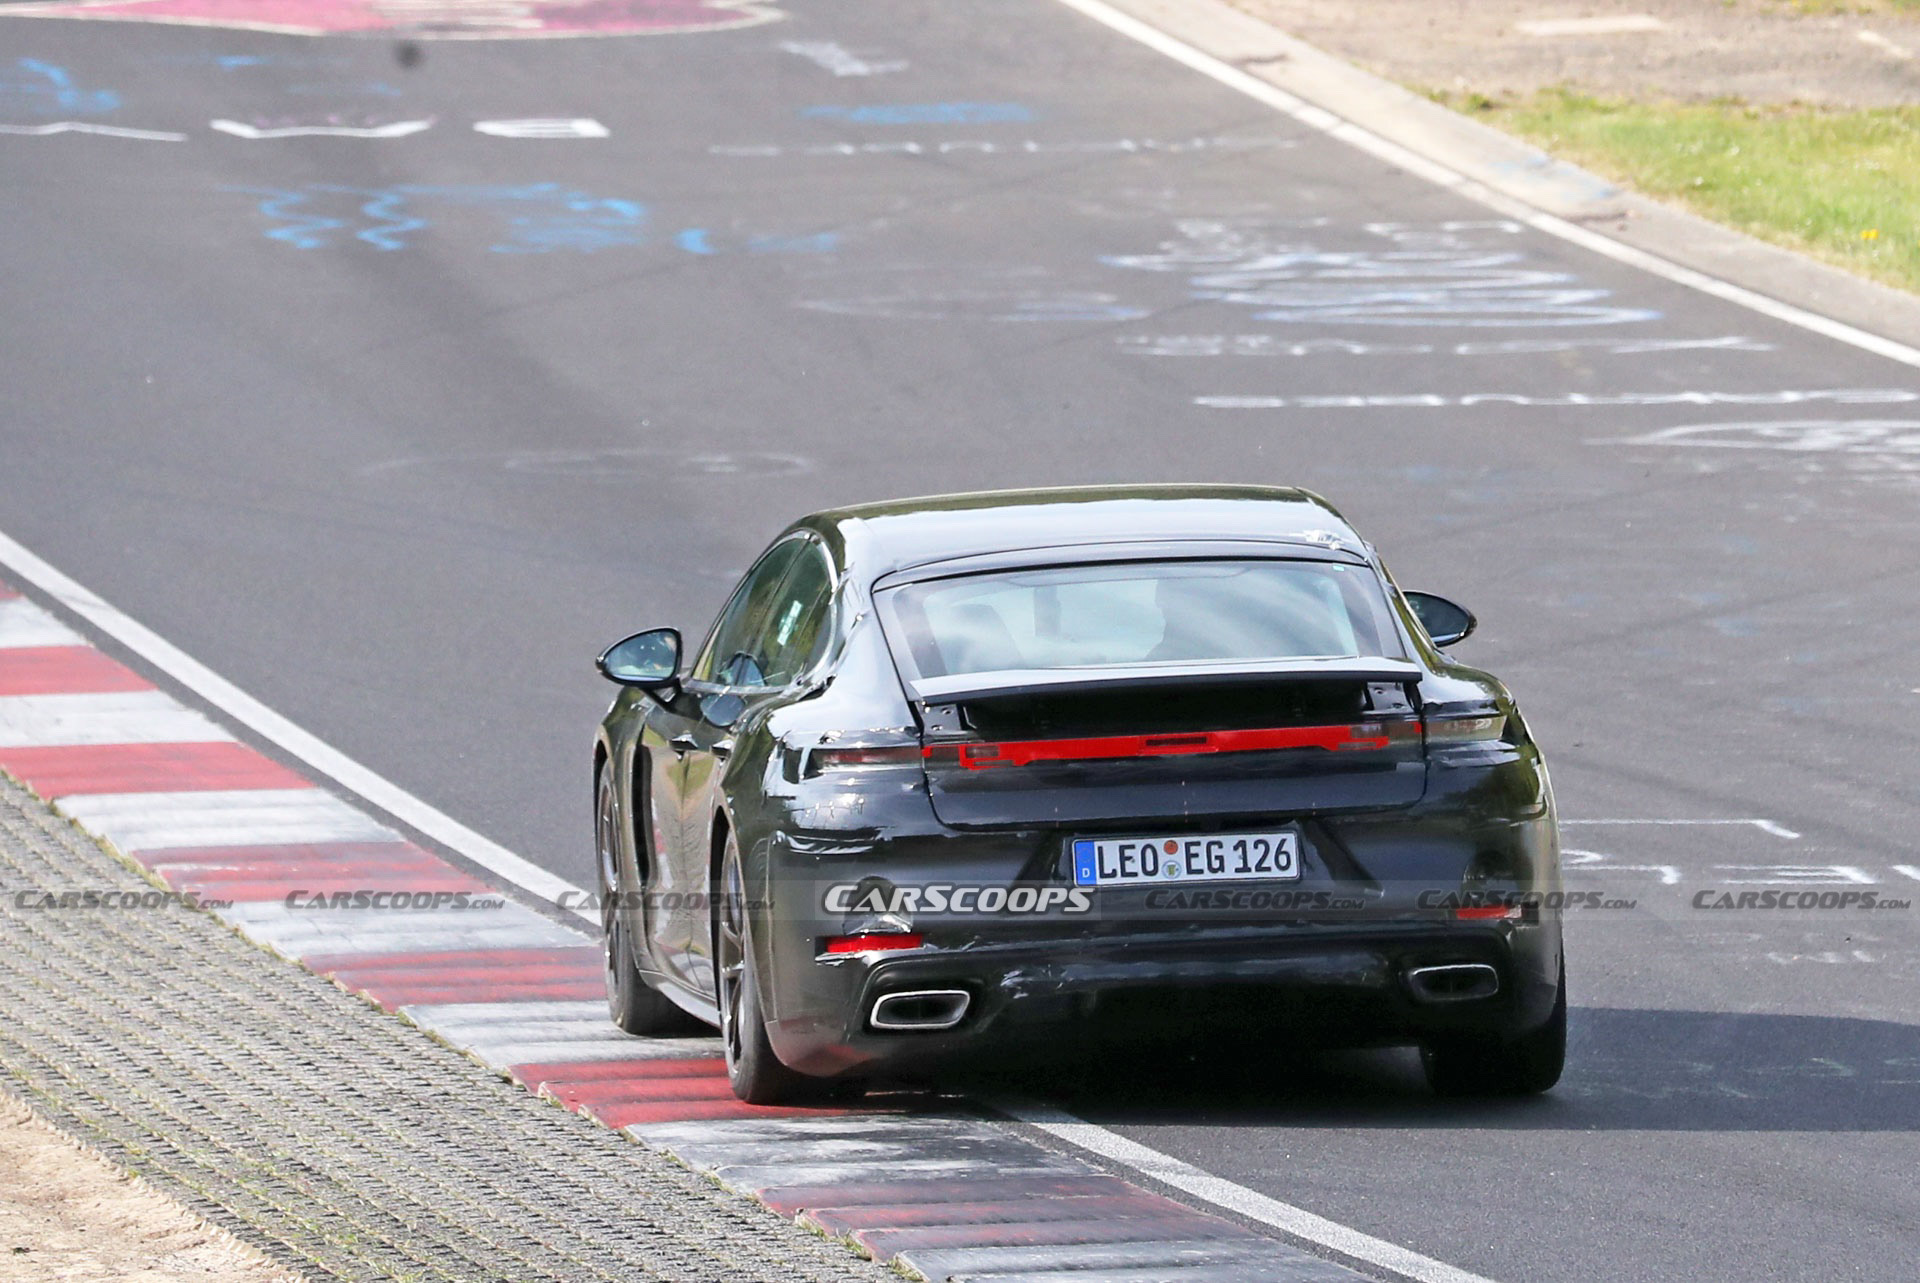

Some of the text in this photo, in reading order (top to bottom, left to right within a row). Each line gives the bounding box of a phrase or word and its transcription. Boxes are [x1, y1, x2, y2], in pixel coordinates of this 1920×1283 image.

[1096, 837, 1293, 880] LEO EG 126
[1081, 867, 1091, 879] D
